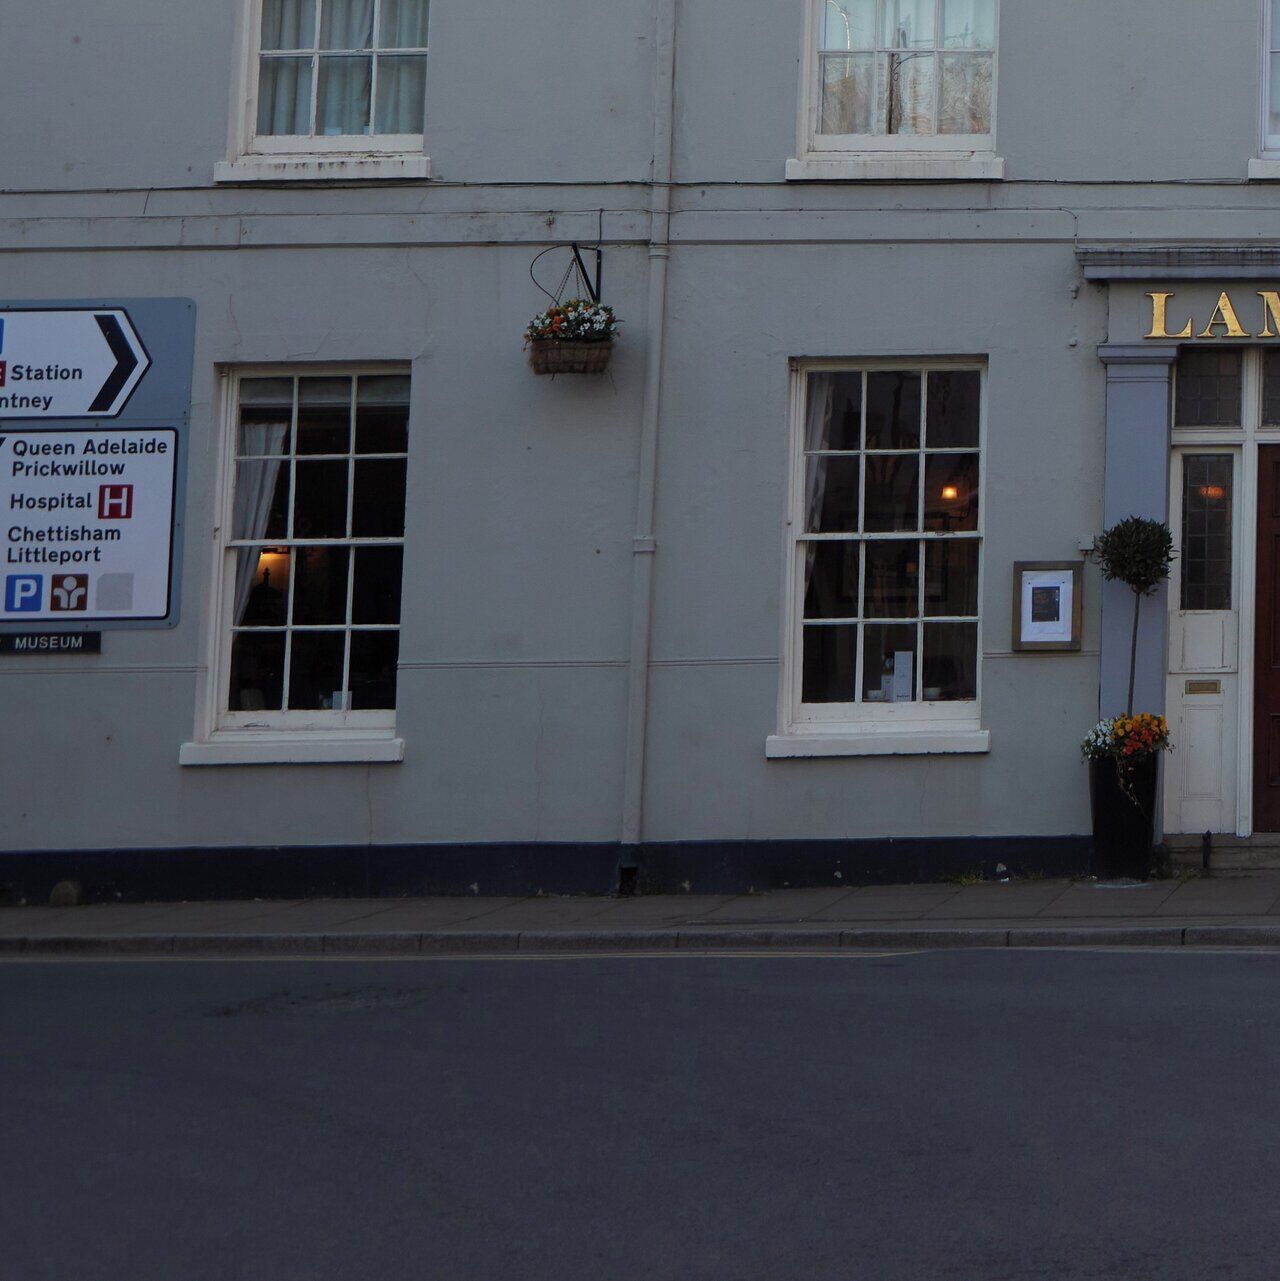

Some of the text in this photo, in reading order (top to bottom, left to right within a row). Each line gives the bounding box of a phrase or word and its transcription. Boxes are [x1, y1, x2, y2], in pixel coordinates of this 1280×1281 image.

[11, 364, 83, 381] Station
[12, 438, 168, 458] Queen Adelaide
[12, 460, 125, 477] Prickwillow
[10, 493, 92, 512] Hospital
[8, 526, 121, 543] Chettisham
[7, 546, 101, 564] Littleport
[15, 636, 83, 649] MUSEUM
